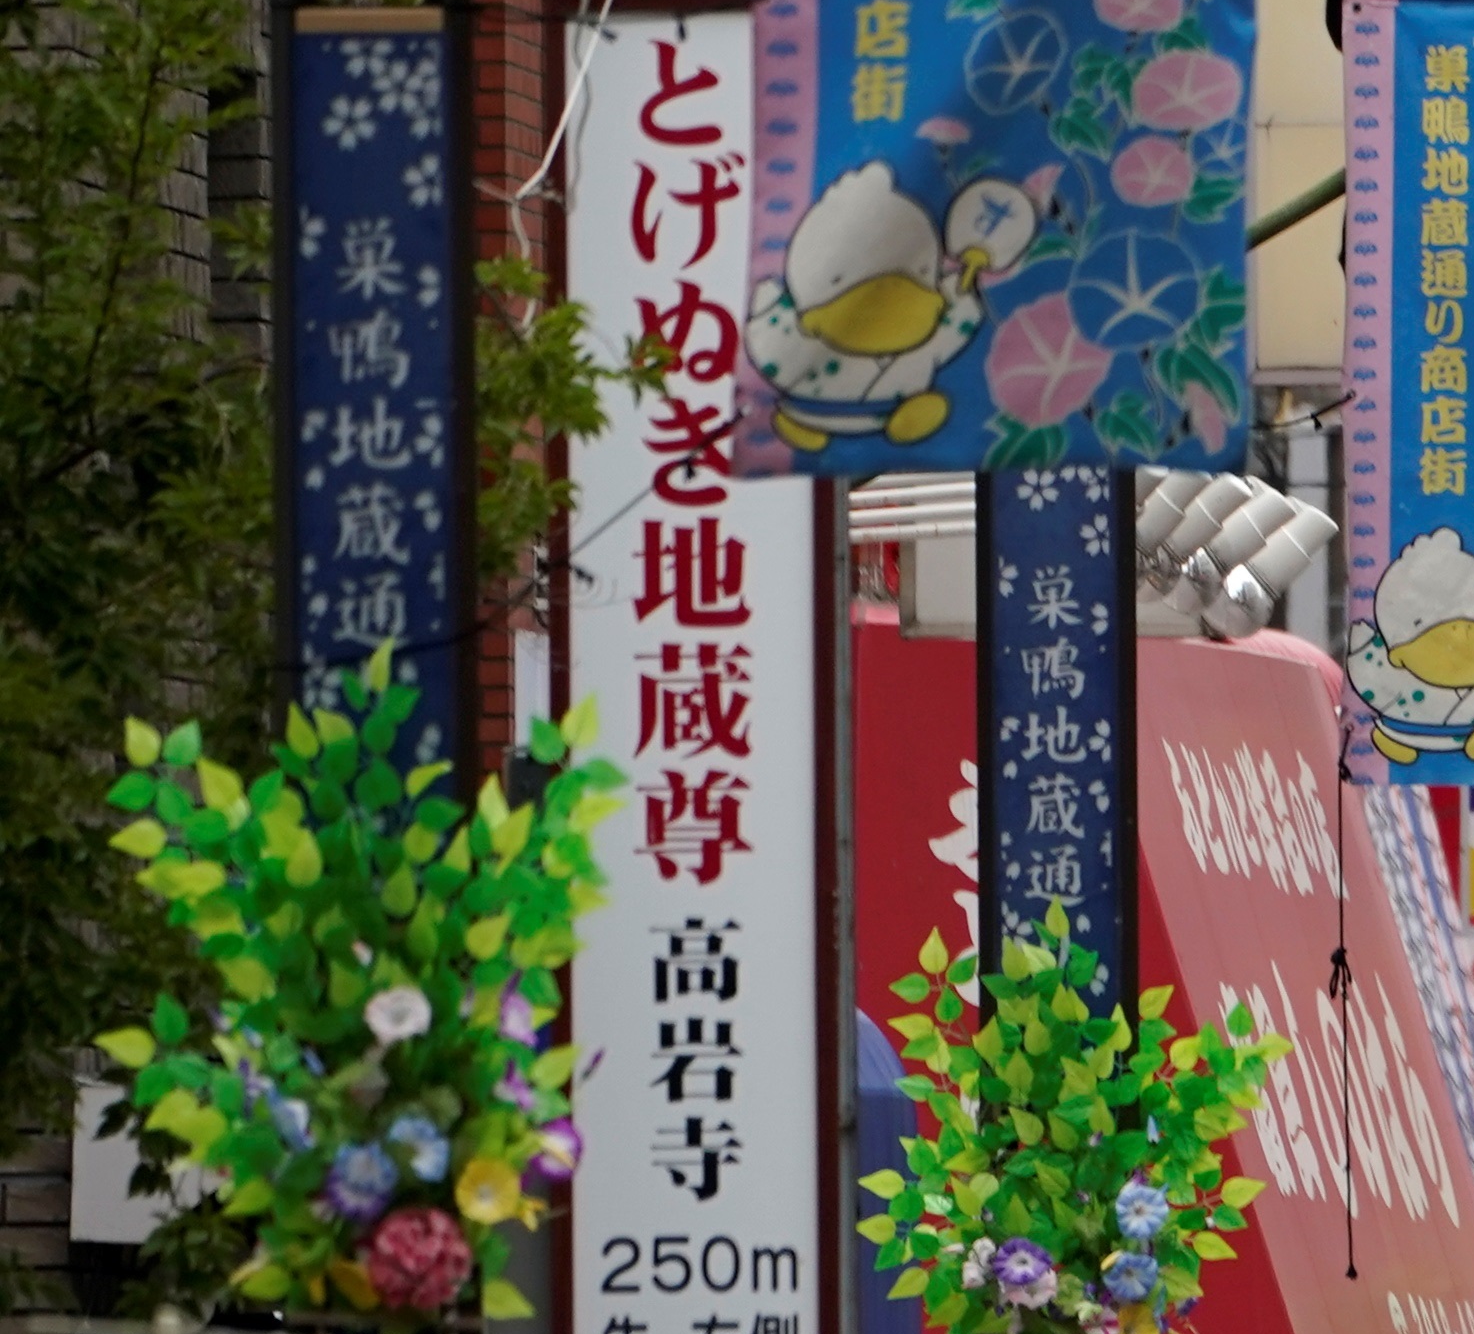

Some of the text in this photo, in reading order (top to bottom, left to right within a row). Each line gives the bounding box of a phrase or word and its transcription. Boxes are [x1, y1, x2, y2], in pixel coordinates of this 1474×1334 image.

[327, 217, 411, 648] 巣鴨地蔵通
[630, 40, 754, 883] とげぬき地蔵尊
[1420, 44, 1470, 498] 巣鴨地蔵通り商店街
[1023, 566, 1089, 909] 巣鴨地蔵通
[650, 917, 743, 1202] 高岩寺
[602, 1237, 799, 1293] 250m
